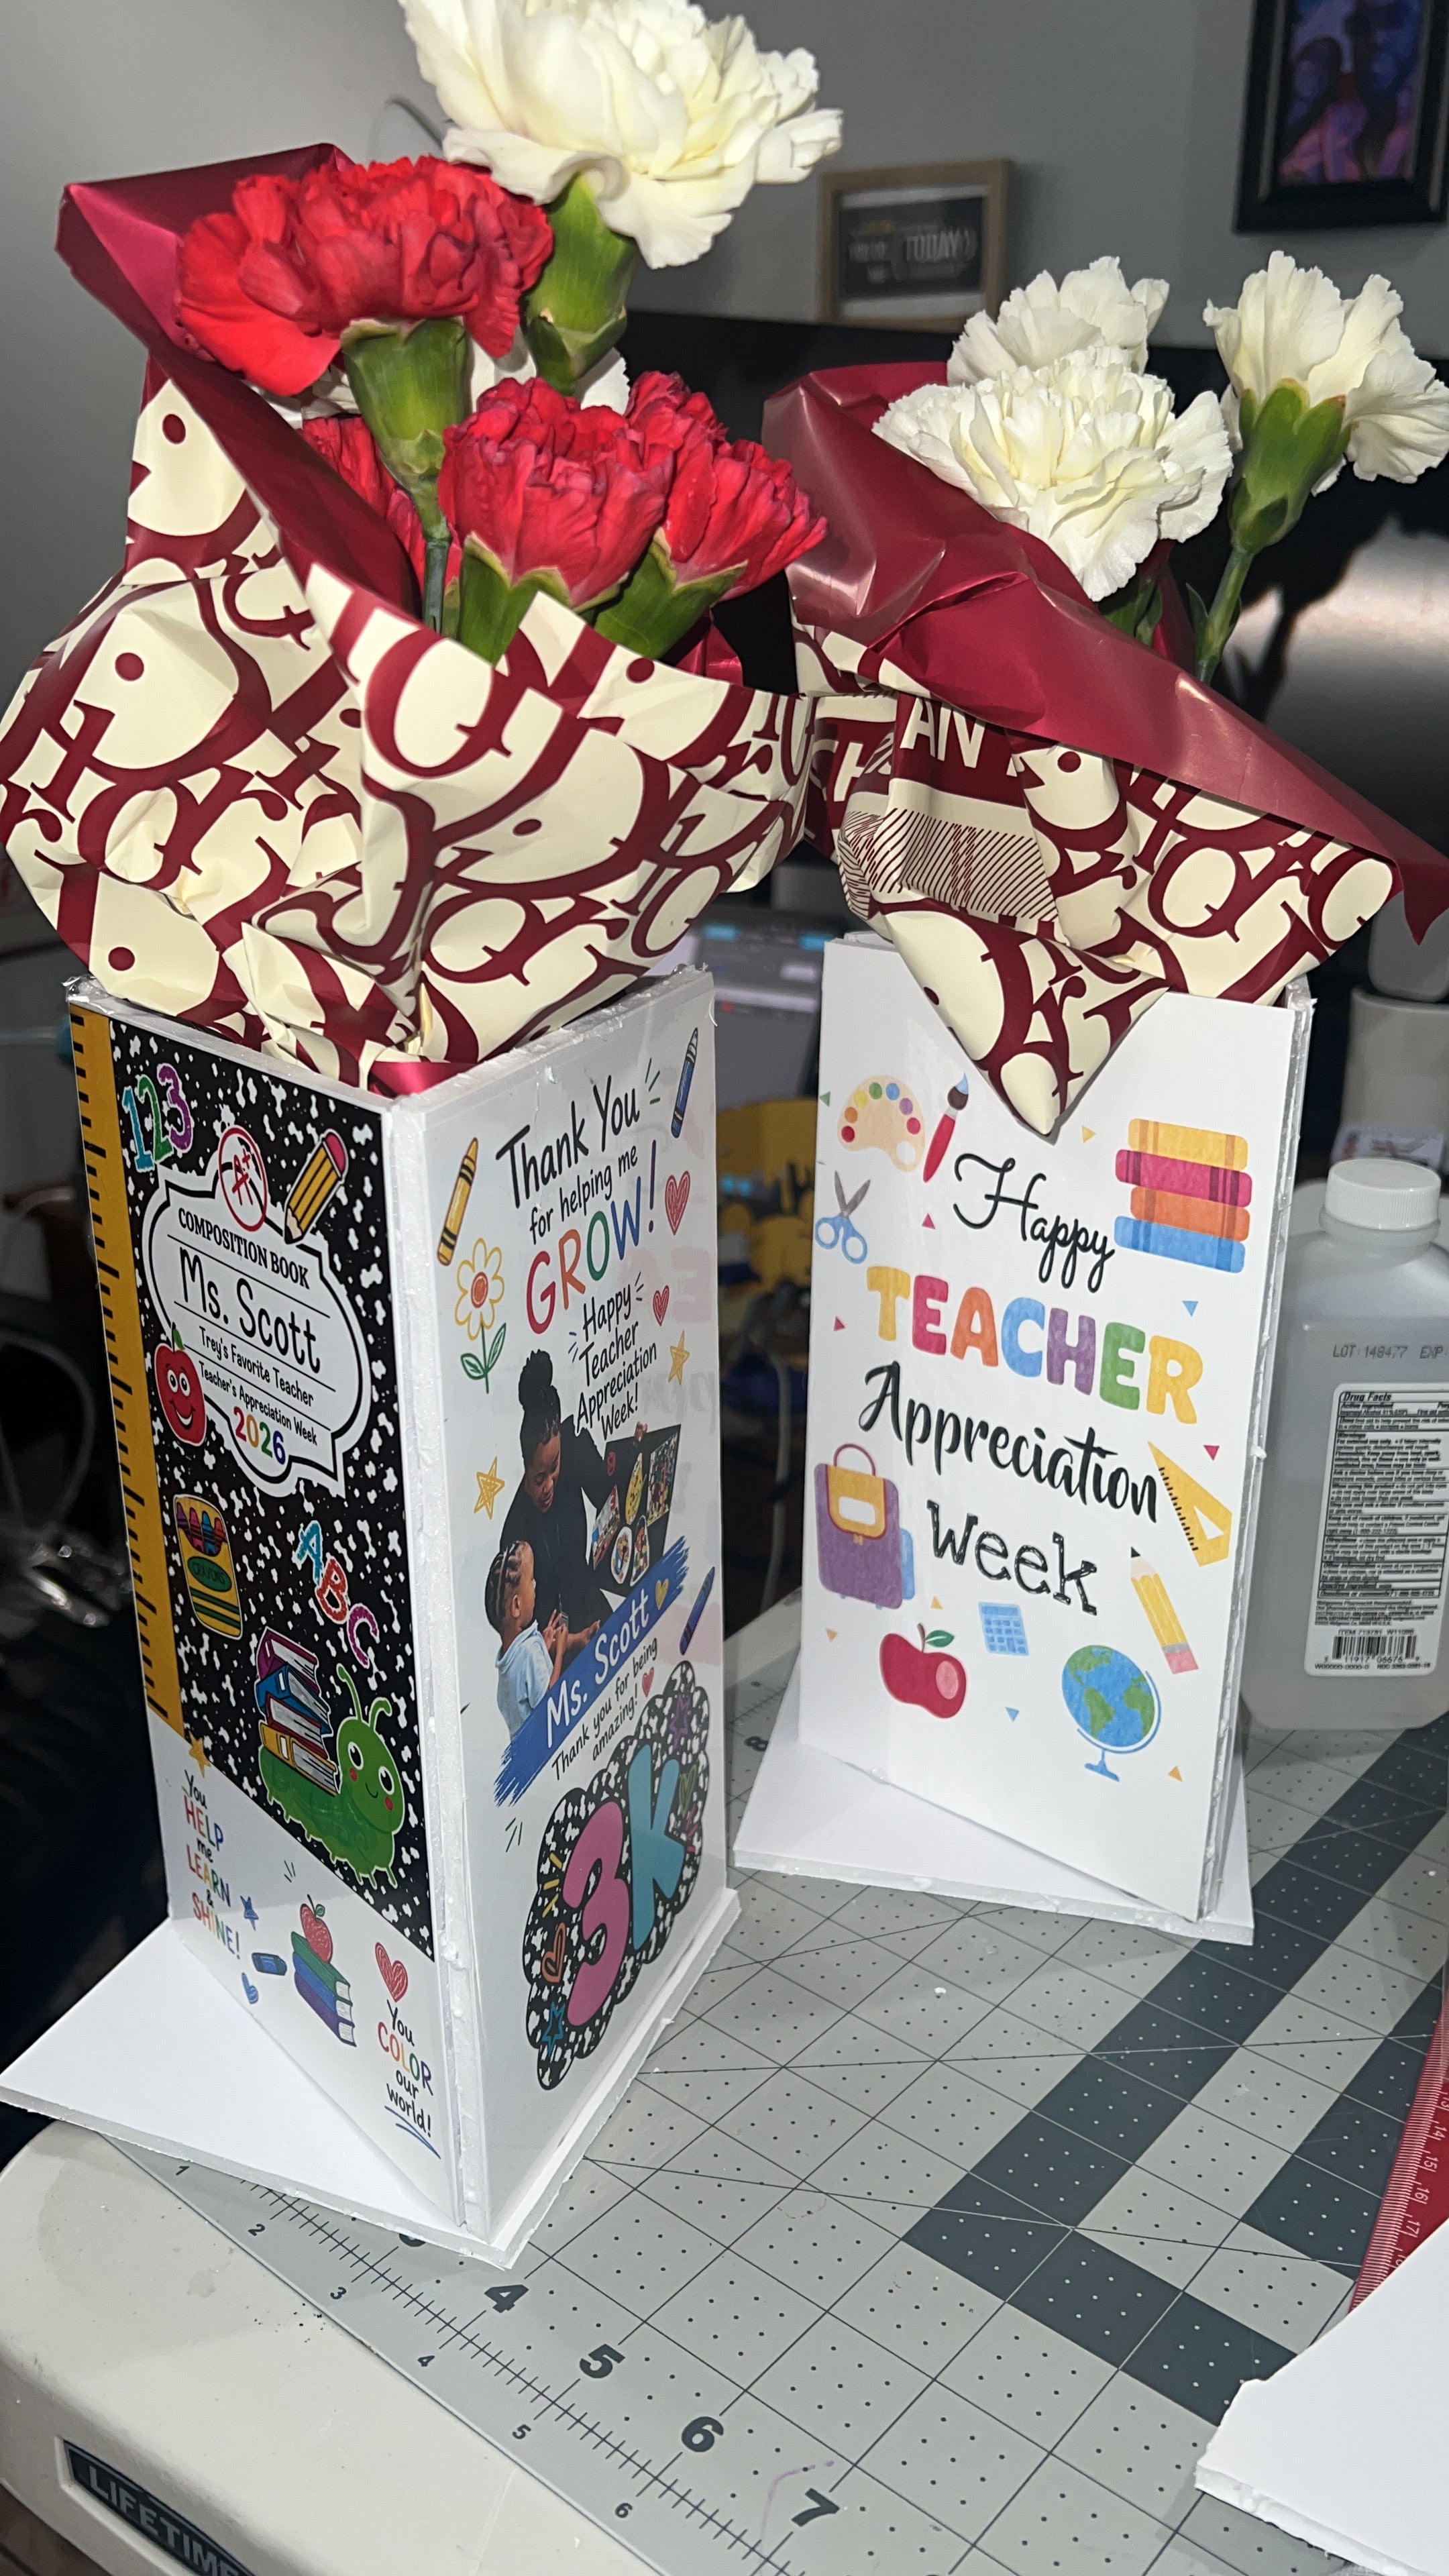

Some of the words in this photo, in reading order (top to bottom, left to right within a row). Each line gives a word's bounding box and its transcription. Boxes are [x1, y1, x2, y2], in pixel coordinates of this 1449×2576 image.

[121, 1063, 193, 1173] 123
[495, 1101, 589, 1208] Thank
[592, 1075, 640, 1152] You
[231, 1148, 252, 1205] A+
[529, 1205, 554, 1244] for
[559, 1167, 613, 1217] helping
[617, 1145, 638, 1175] me
[178, 1208, 267, 1271] COMPOSITION
[270, 1252, 310, 1289] BOOK
[526, 1140, 657, 1334] GROW!
[953, 1153, 1115, 1293] Happy
[180, 1247, 229, 1324] Ms.
[237, 1278, 320, 1373] Scott
[582, 1284, 631, 1342] Happy
[199, 1326, 229, 1361] Trey's
[231, 1346, 270, 1383] Favorite
[273, 1367, 313, 1407] Teacher
[579, 1321, 639, 1387] Teacher
[865, 1265, 1203, 1424] TEACHER
[199, 1360, 237, 1397] Teacher's
[239, 1385, 291, 1430] Appreciation
[293, 1422, 317, 1446] Week
[577, 1342, 657, 1434] Appreciation
[602, 1382, 639, 1441] Week!
[1343, 1391, 1366, 1402] Drug
[1367, 1391, 1393, 1402] Facts
[233, 1406, 286, 1464] 2026
[859, 1360, 1159, 1523] Appreciation
[191, 1560, 226, 1585] CRAYONS
[926, 1499, 1098, 1617] Week
[298, 1521, 379, 1668] ABC
[546, 1680, 588, 1749] Ms.
[594, 1588, 649, 1686] Scott
[552, 1735, 590, 1781] Thank
[593, 1699, 612, 1739] you
[614, 1672, 630, 1705] for
[633, 1637, 658, 1680] being
[592, 1684, 639, 1762] amazing!
[184, 1769, 207, 1809] You
[184, 1794, 224, 1851] HELP
[197, 1837, 213, 1863] me
[186, 1843, 231, 1907] LEARN
[206, 1889, 214, 1909] &
[562, 1744, 685, 2027] 3K
[192, 1892, 240, 1960] SHINE!
[387, 1999, 415, 2047] You
[378, 2021, 433, 2096] COLOR
[396, 2070, 419, 2099] our
[386, 2083, 431, 2137] world!
[1433, 2125, 1448, 2138] 14
[176, 2165, 189, 2176] 1
[1424, 2156, 1439, 2169] 15
[1414, 2187, 1430, 2201] 16
[248, 2223, 266, 2237] 2
[1406, 2219, 1421, 2235] 17
[330, 2286, 347, 2301] 3
[484, 2284, 529, 2313] 4
[417, 2355, 435, 2367] 4
[579, 2343, 625, 2379] 5
[512, 2423, 531, 2440] 5
[681, 2416, 724, 2453] 6
[614, 2502, 633, 2519] 6
[791, 2487, 841, 2528] 7
